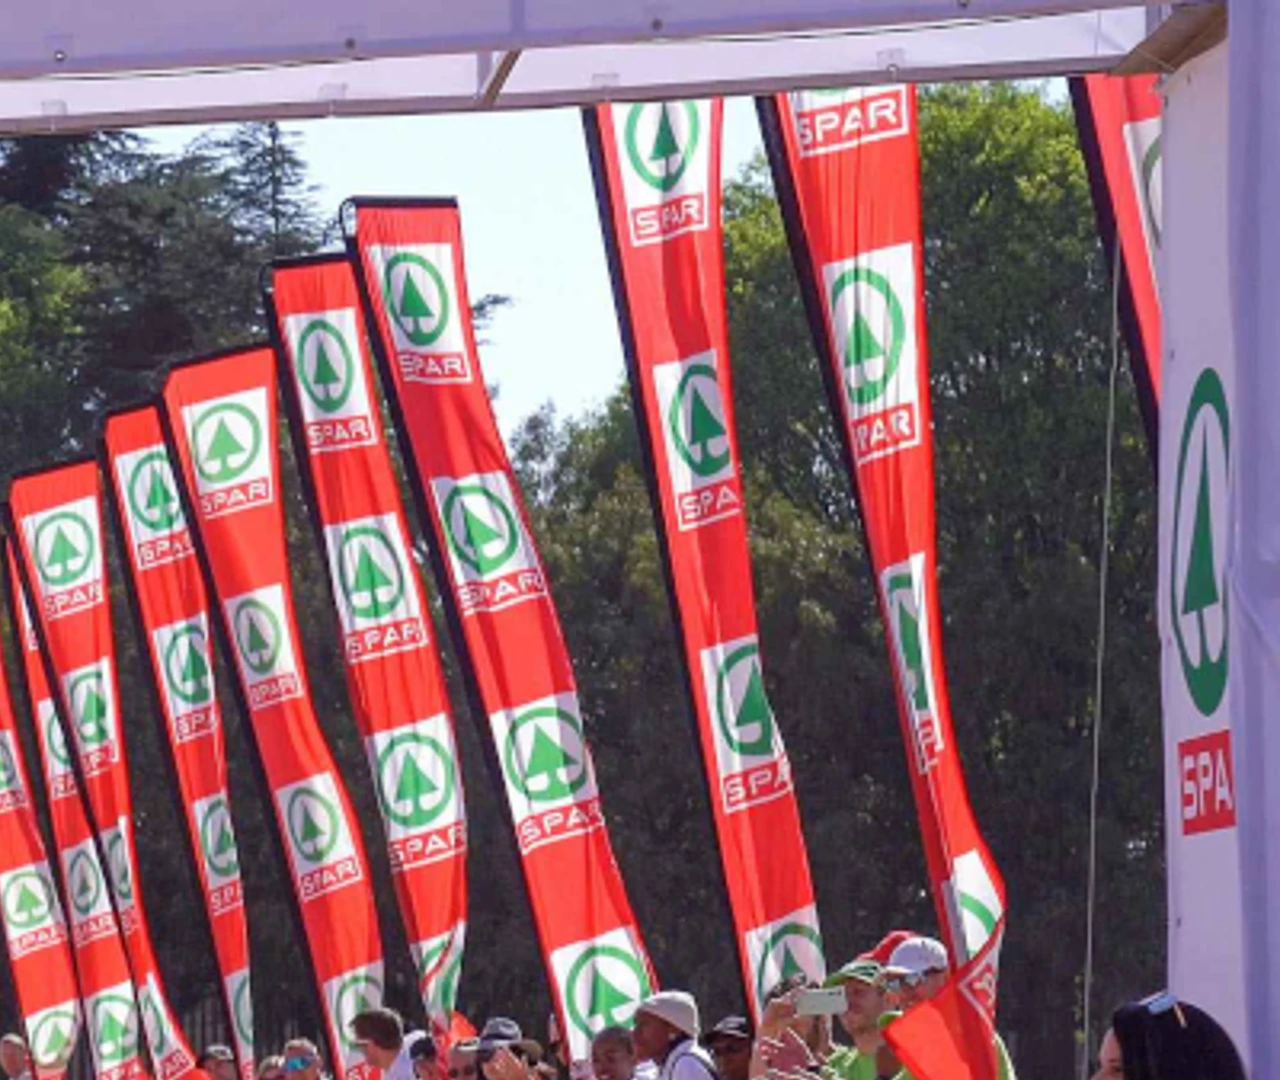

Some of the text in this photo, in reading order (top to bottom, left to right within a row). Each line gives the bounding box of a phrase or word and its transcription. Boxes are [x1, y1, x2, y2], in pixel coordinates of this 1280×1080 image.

[797, 98, 898, 147] SPAR
[633, 198, 702, 236] SPAR
[855, 408, 911, 448] PAR
[680, 485, 740, 520] SPA
[724, 763, 791, 804] SPA
[1181, 748, 1233, 820] SPA
